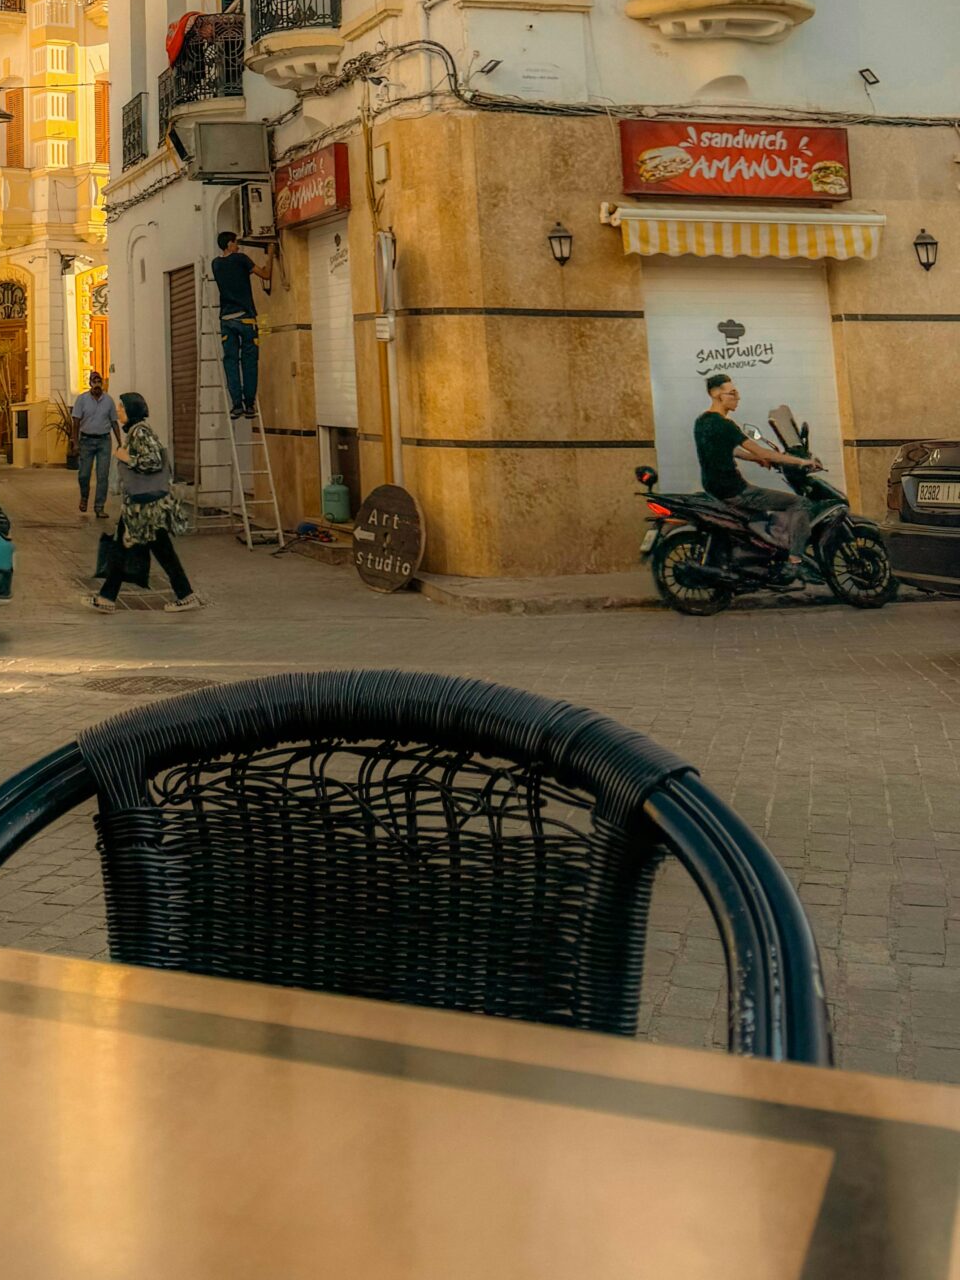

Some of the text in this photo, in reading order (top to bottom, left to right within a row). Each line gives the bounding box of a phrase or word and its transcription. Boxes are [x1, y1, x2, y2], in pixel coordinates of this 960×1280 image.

[700, 129, 788, 150] sandwich
[696, 343, 774, 363] SANDWICH
[368, 509, 400, 529] Art
[356, 551, 411, 575] studio
